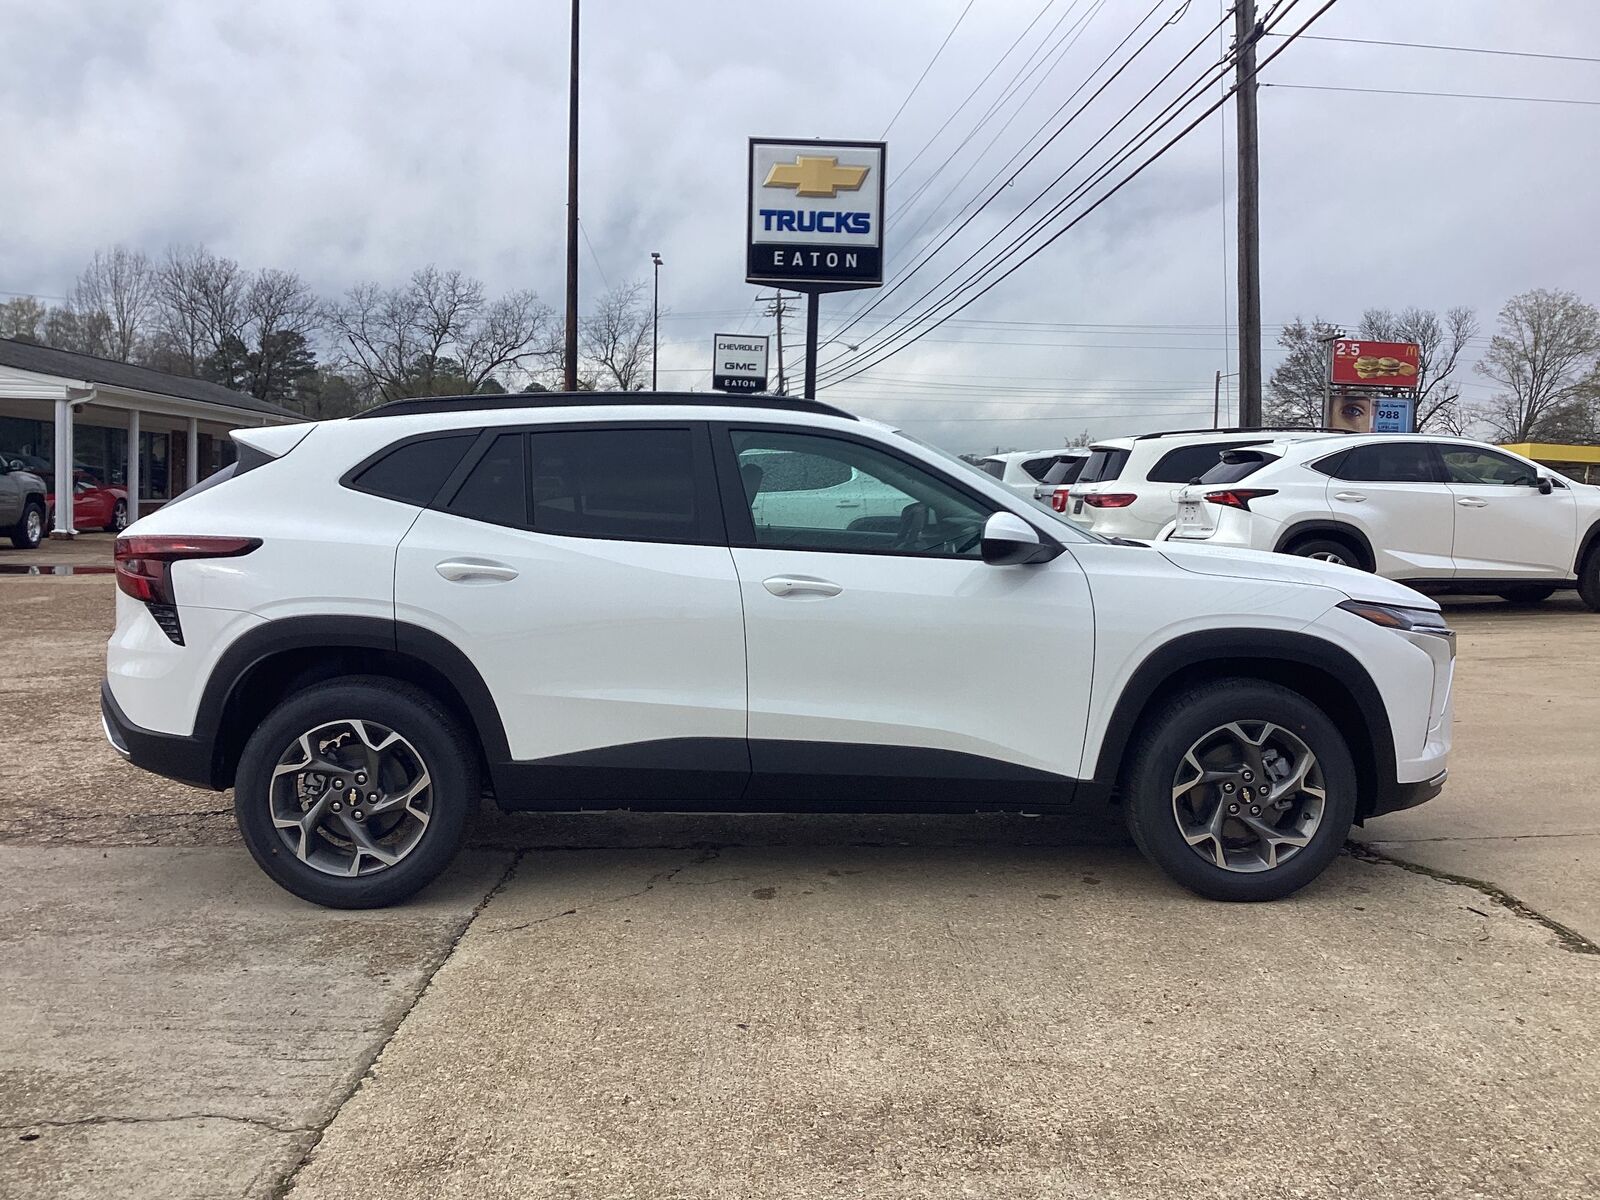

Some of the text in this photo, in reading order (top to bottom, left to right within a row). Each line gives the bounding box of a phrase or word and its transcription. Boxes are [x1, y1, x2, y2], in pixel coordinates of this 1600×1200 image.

[760, 209, 870, 234] TRUCKS
[774, 251, 857, 268] EATON
[718, 343, 764, 351] CHEVROLET
[1336, 342, 1346, 355] 2
[724, 362, 757, 370] GMC
[724, 379, 756, 387] EATON
[1378, 410, 1400, 420] 988
